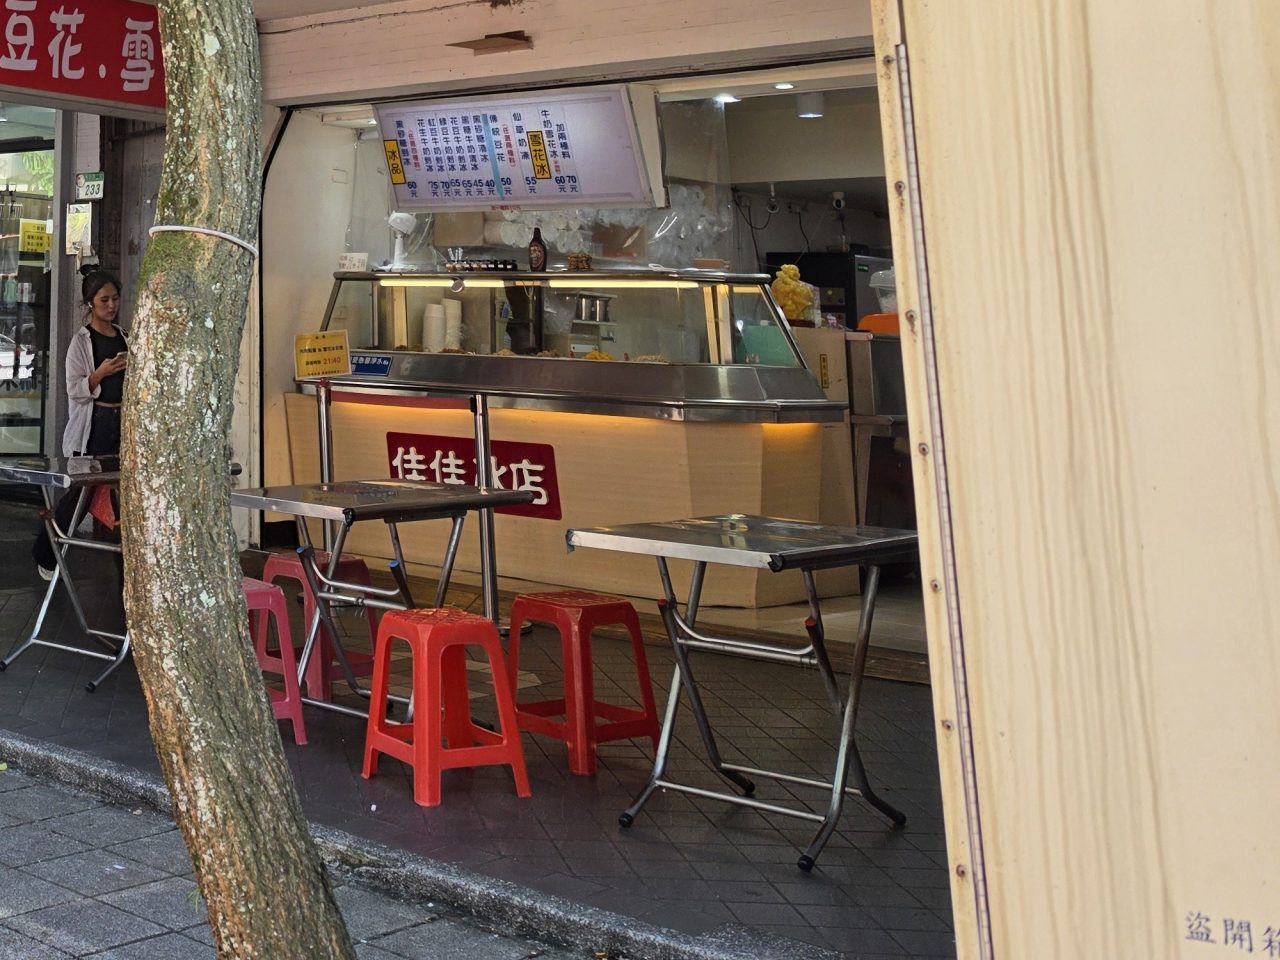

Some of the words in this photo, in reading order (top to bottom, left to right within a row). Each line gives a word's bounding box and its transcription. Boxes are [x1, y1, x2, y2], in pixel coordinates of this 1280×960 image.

[387, 149, 401, 175] 冰品
[530, 133, 549, 176] 雪花冰
[85, 183, 101, 196] 233
